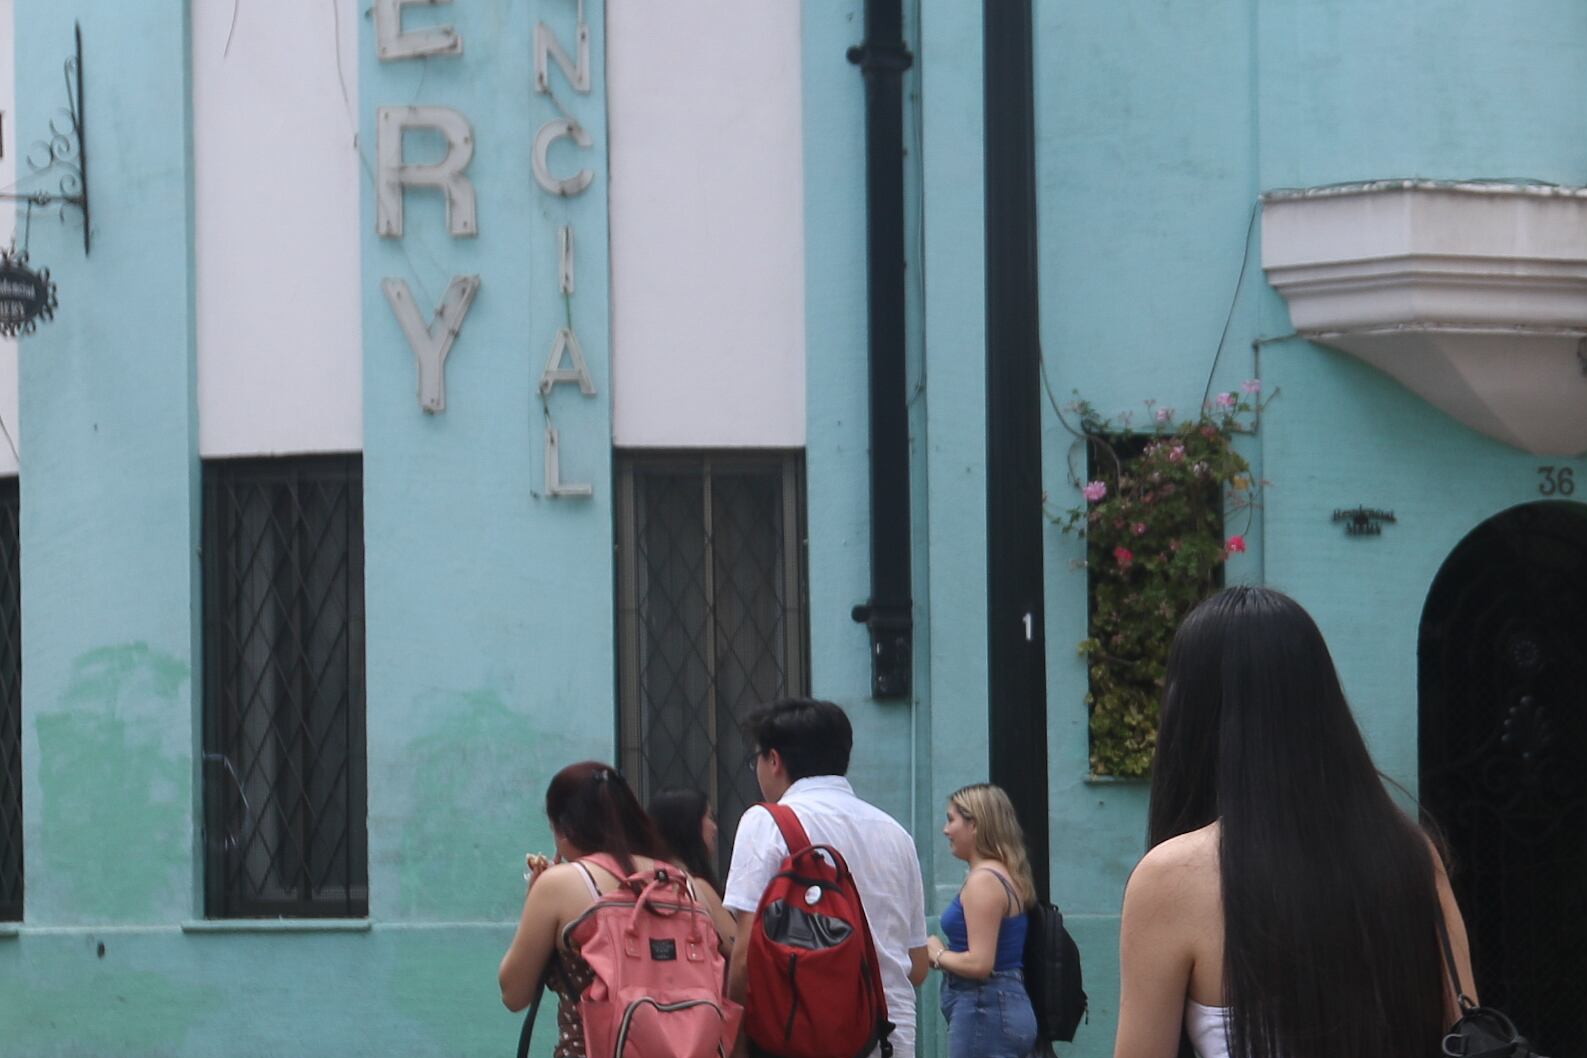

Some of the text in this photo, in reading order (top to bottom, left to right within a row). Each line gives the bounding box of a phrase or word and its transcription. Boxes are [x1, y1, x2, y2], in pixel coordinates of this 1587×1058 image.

[531, 0, 597, 498] NCIAL
[1536, 466, 1575, 496] 36
[1022, 612, 1032, 641] 1
